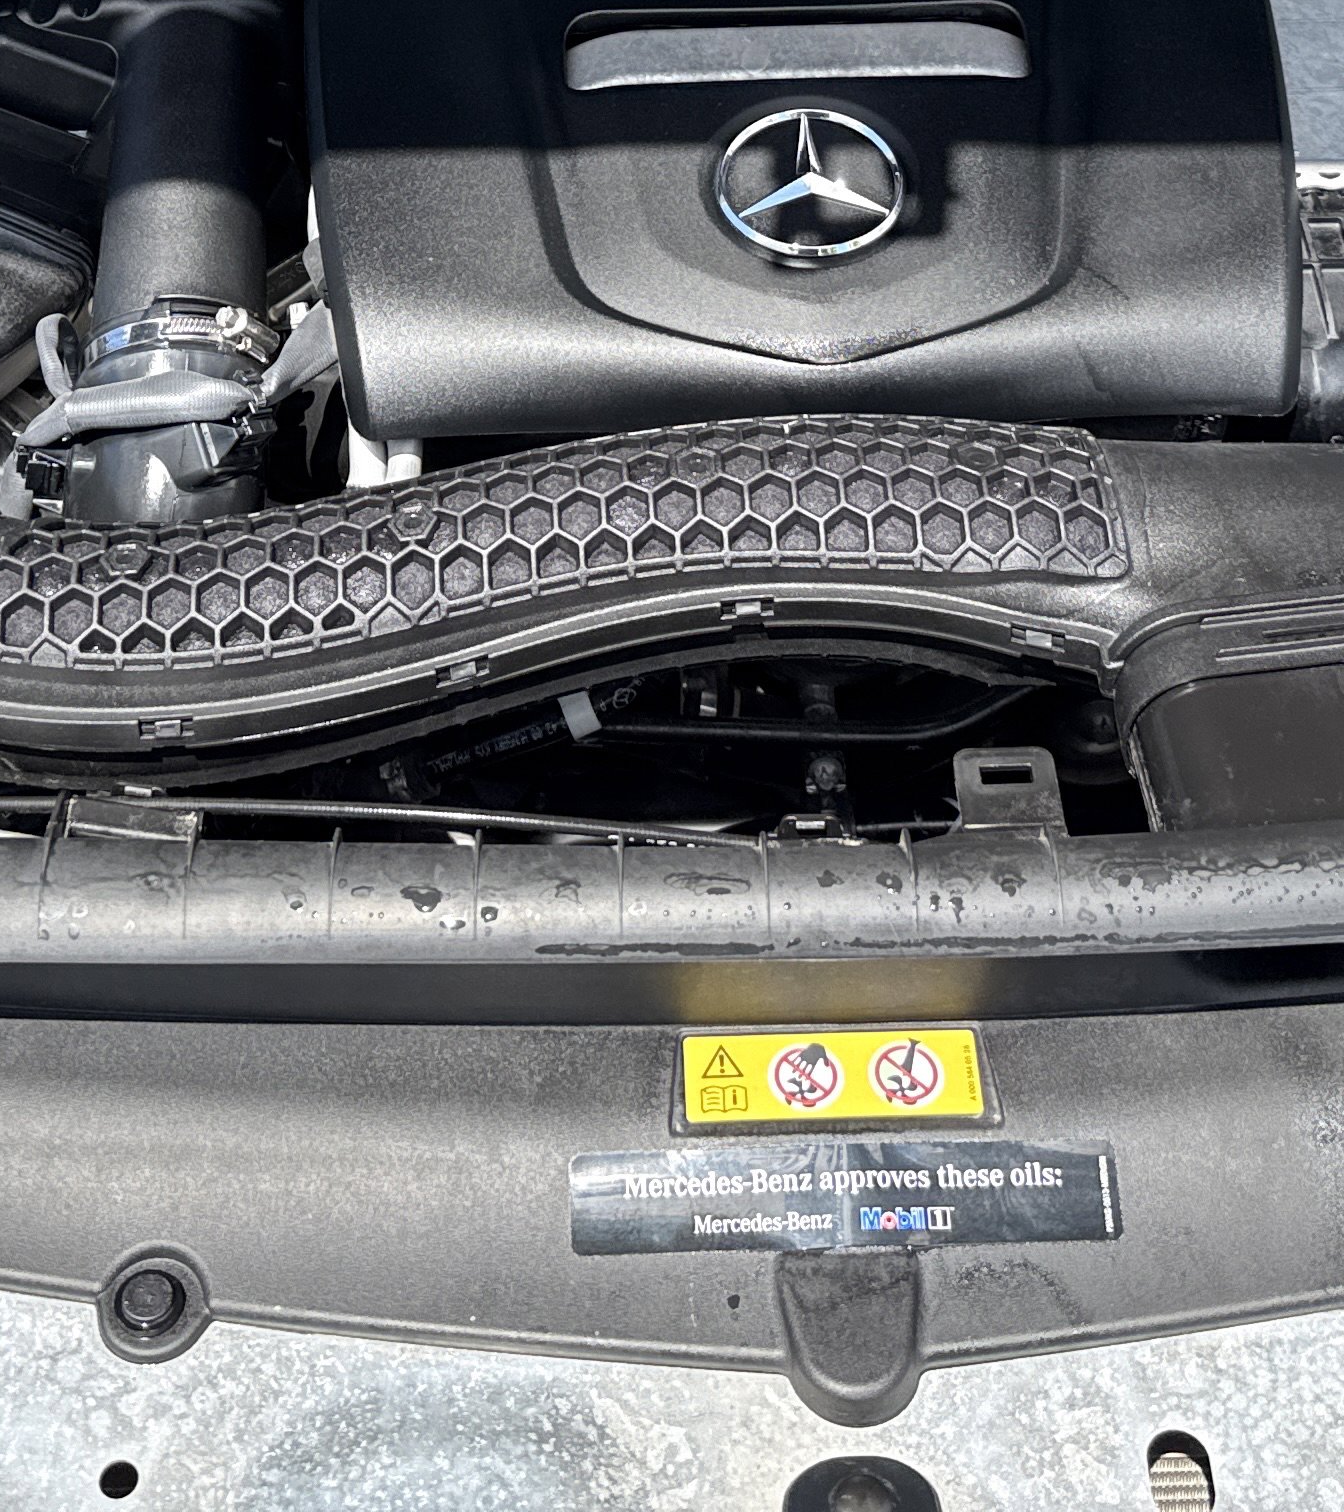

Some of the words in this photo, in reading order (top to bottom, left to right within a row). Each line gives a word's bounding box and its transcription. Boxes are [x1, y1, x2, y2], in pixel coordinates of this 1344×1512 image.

[623, 1168, 813, 1199] Mercedes-Benz
[819, 1167, 931, 1194] approves
[937, 1162, 1005, 1188] these
[1009, 1161, 1063, 1188] oils:
[693, 1210, 833, 1235] Mercedes-Benz
[859, 1206, 927, 1231] Mobil
